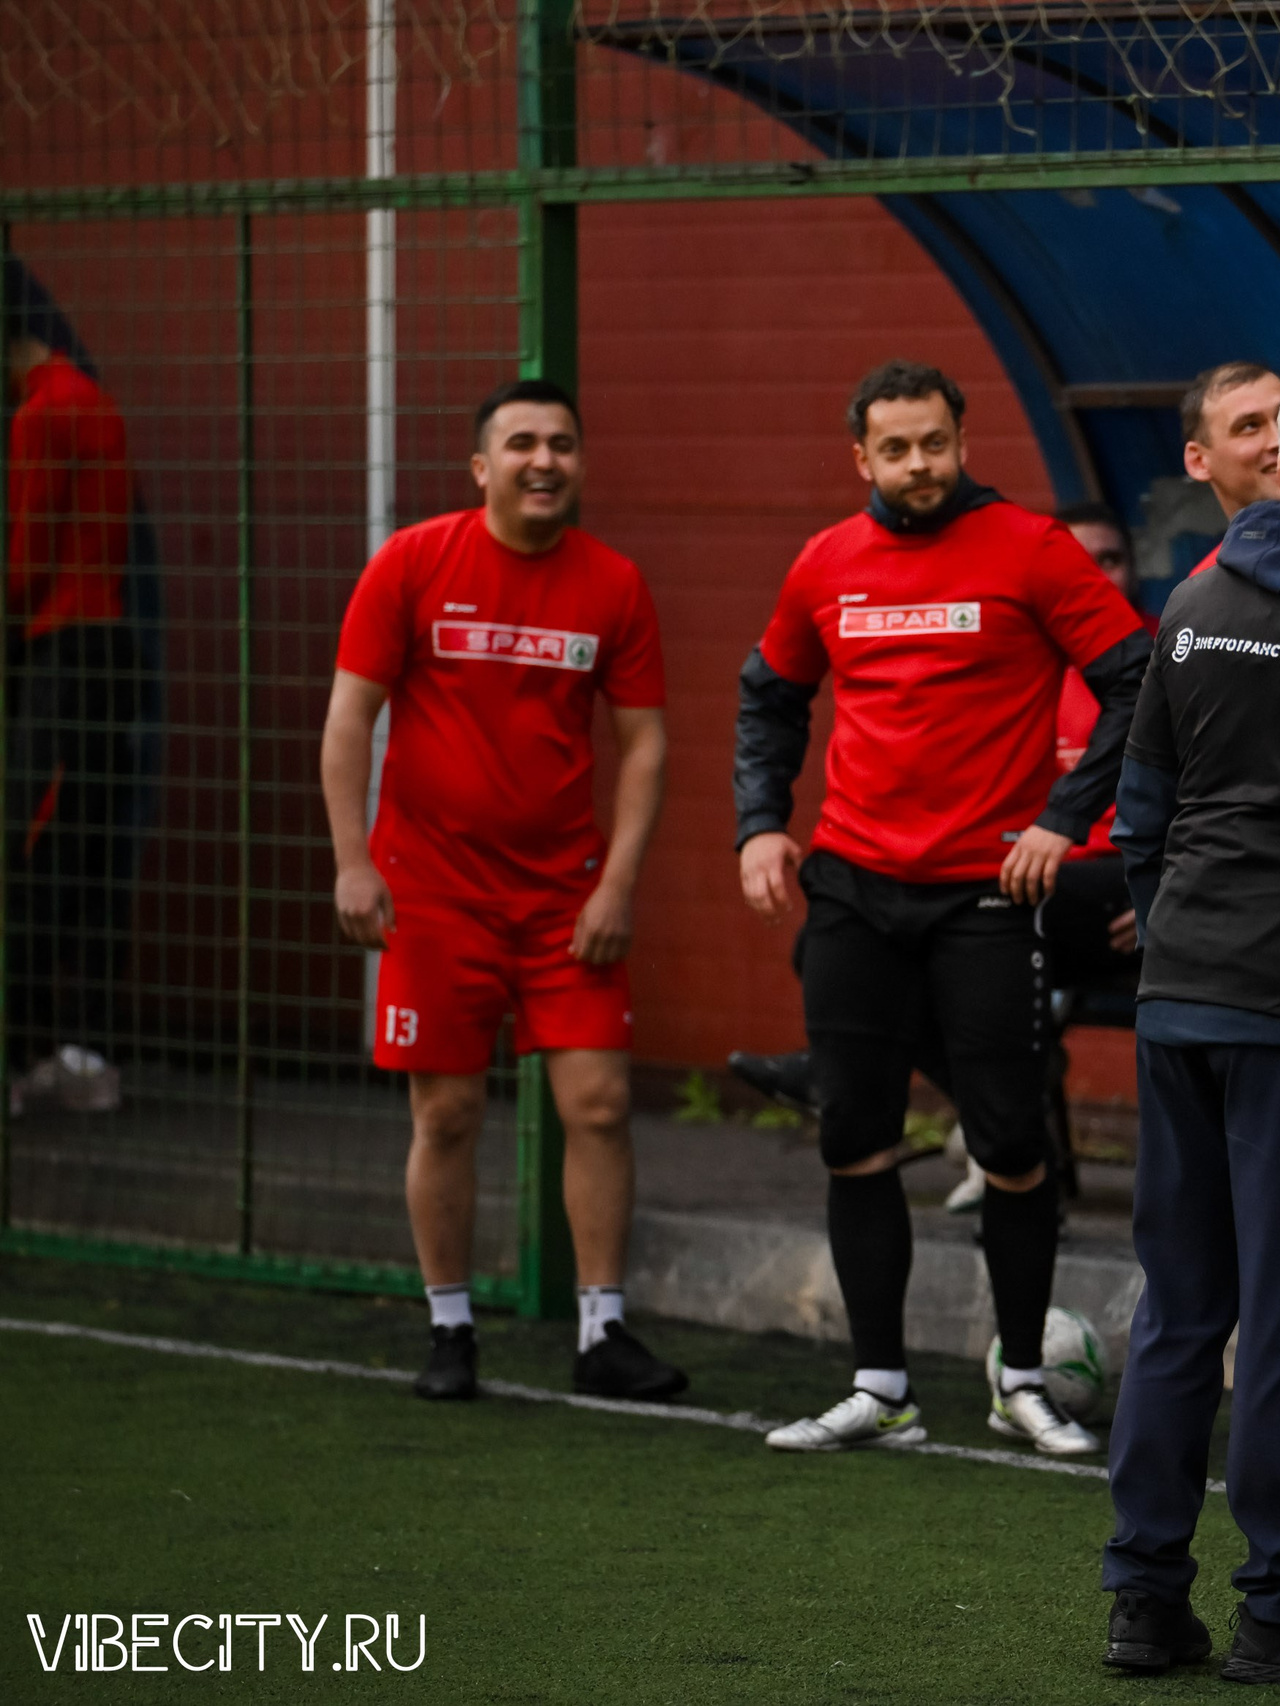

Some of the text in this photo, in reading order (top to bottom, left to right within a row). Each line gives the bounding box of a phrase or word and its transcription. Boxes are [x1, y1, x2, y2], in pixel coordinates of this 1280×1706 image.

[866, 610, 945, 631] SPAR
[467, 630, 562, 659] SPAR
[385, 1004, 419, 1047] 13
